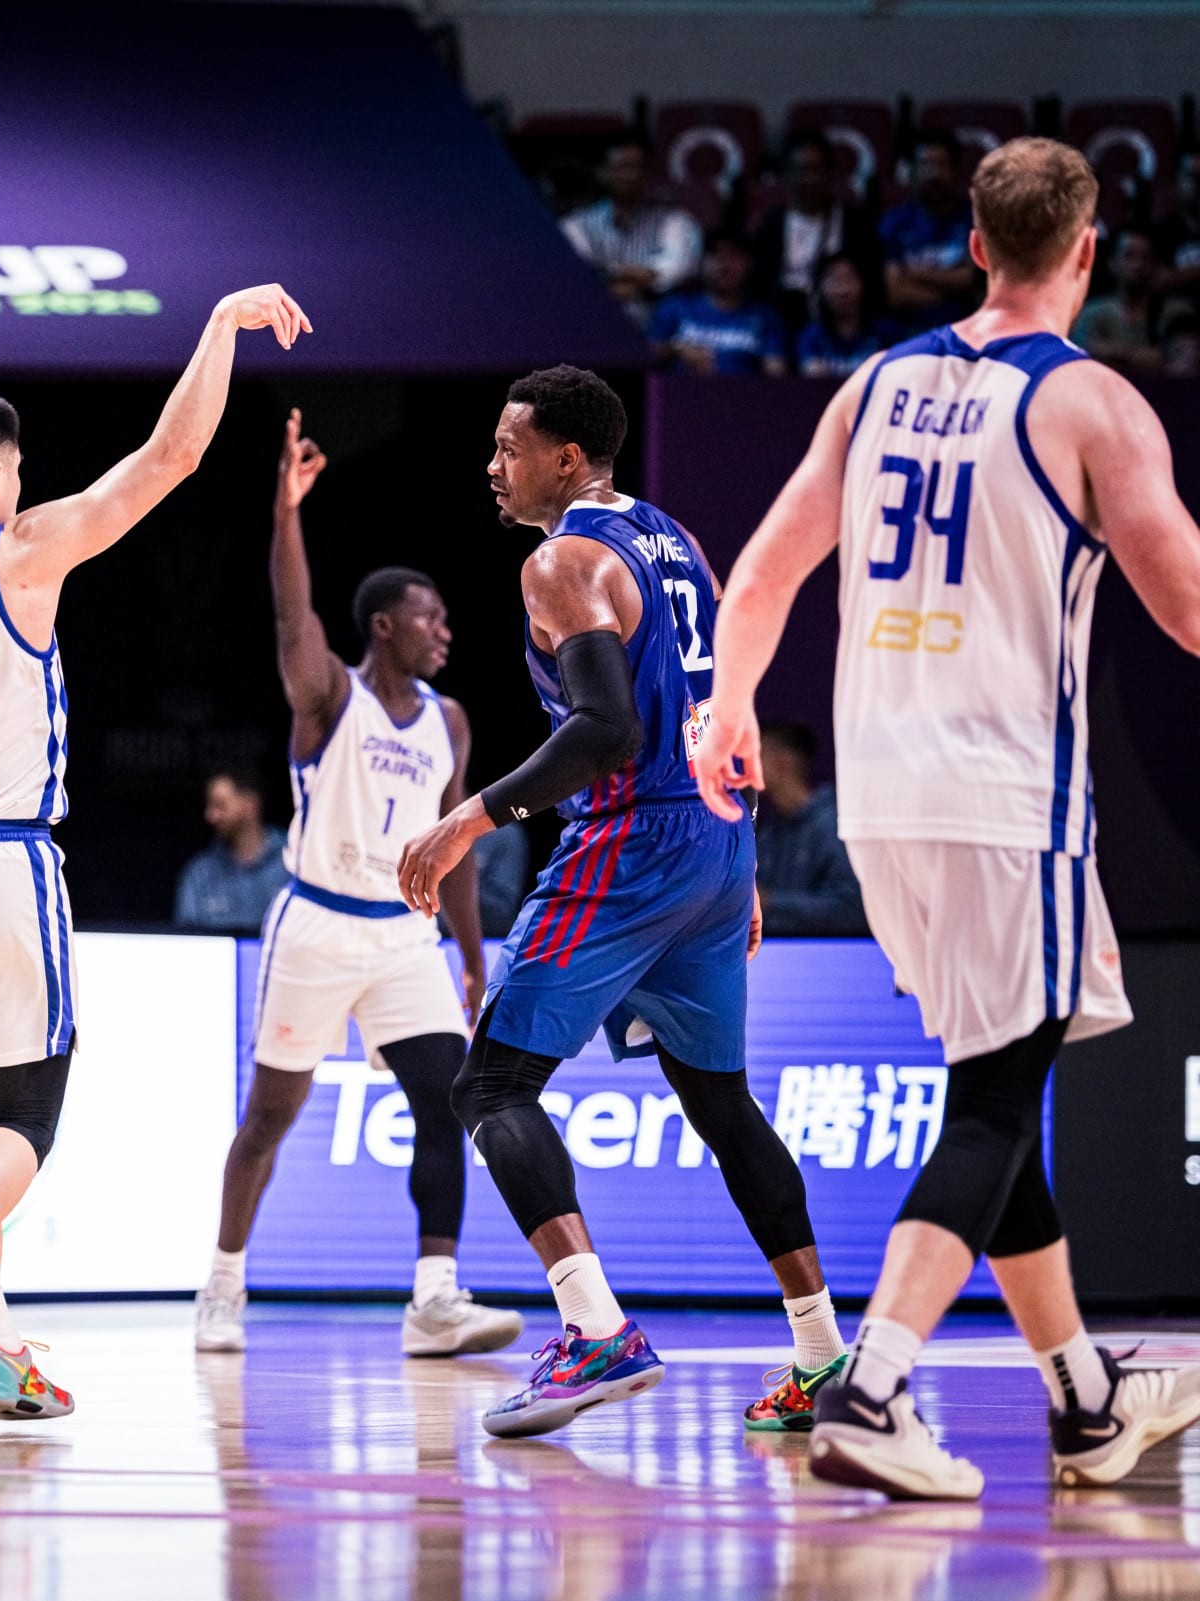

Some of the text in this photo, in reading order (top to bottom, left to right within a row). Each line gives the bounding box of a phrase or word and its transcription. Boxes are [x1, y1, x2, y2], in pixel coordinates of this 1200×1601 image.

[868, 454, 975, 585] 34
[867, 608, 964, 655] BC
[382, 797, 396, 836] 1
[774, 1063, 949, 1169] 腾讯
